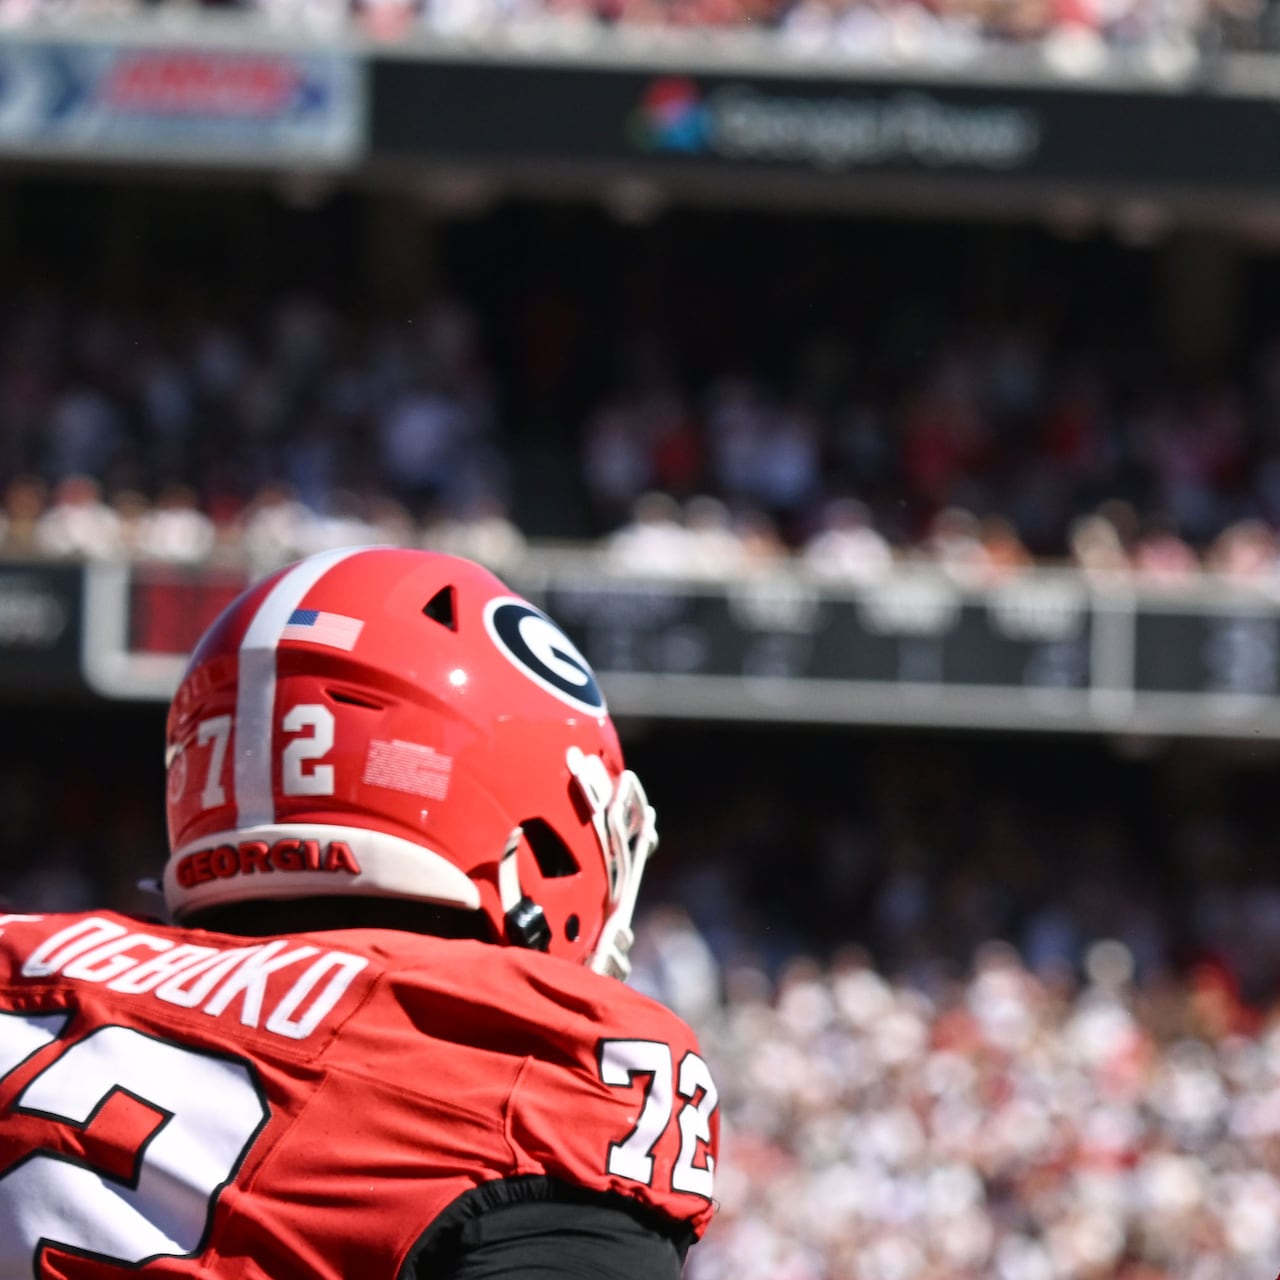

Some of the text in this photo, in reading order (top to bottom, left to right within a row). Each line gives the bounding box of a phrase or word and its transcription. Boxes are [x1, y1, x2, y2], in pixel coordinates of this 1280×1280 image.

[176, 839, 362, 889] GEORGIA
[21, 916, 370, 1040] OGBOKO
[594, 1037, 720, 1204] 72
